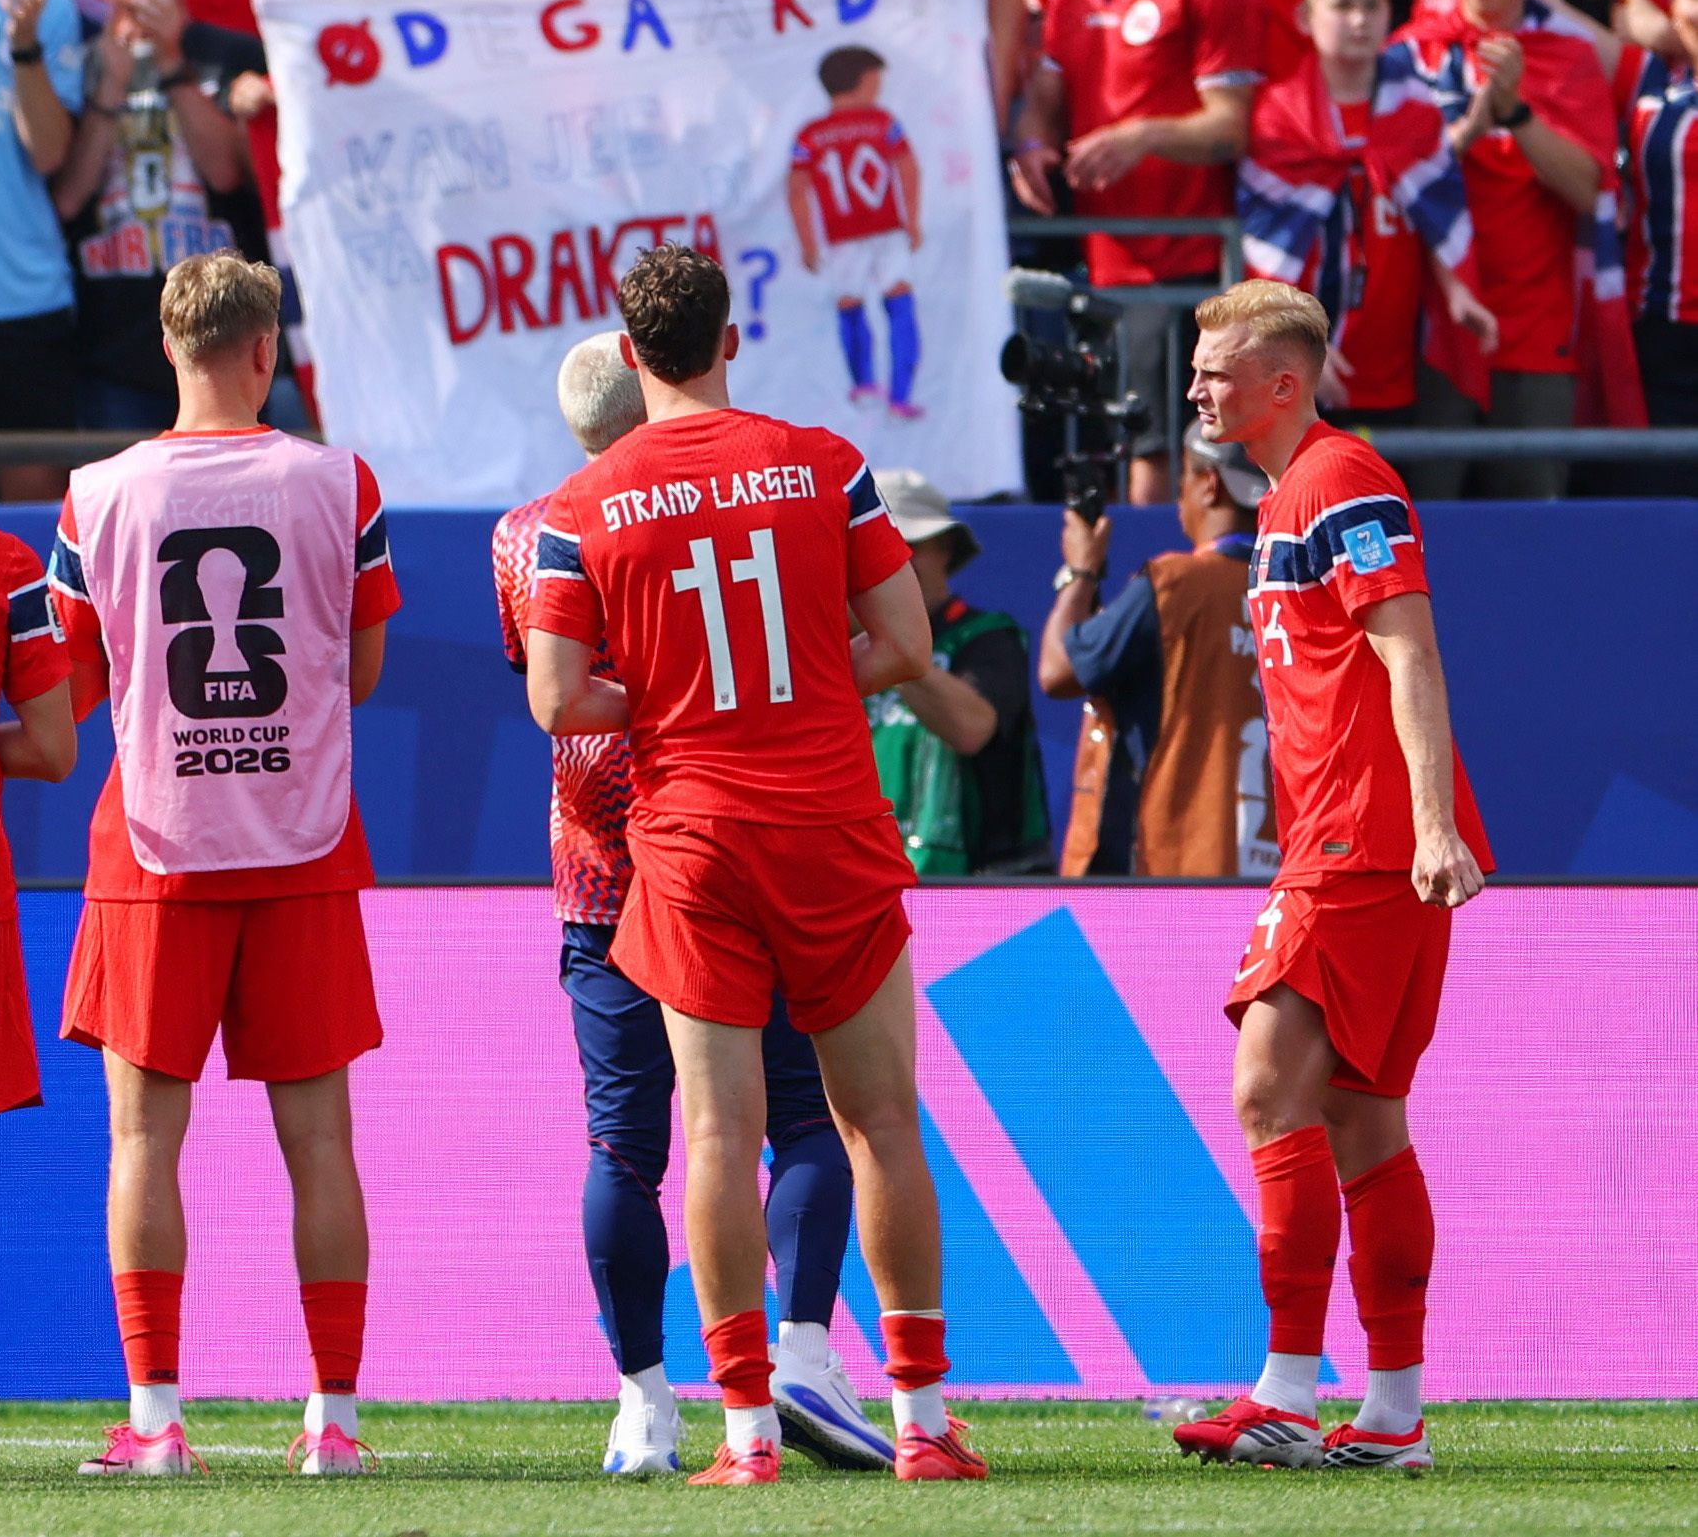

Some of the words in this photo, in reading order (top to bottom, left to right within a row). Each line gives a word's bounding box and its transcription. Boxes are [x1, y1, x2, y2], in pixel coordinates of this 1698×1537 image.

[816, 145, 892, 217] 10
[600, 480, 703, 533] STRAND
[709, 464, 817, 510] LARSEN
[670, 528, 794, 712] 11
[205, 681, 257, 703] FIFA
[173, 726, 246, 747] WORLD
[249, 725, 291, 743] CUP
[175, 746, 292, 778] 2026
